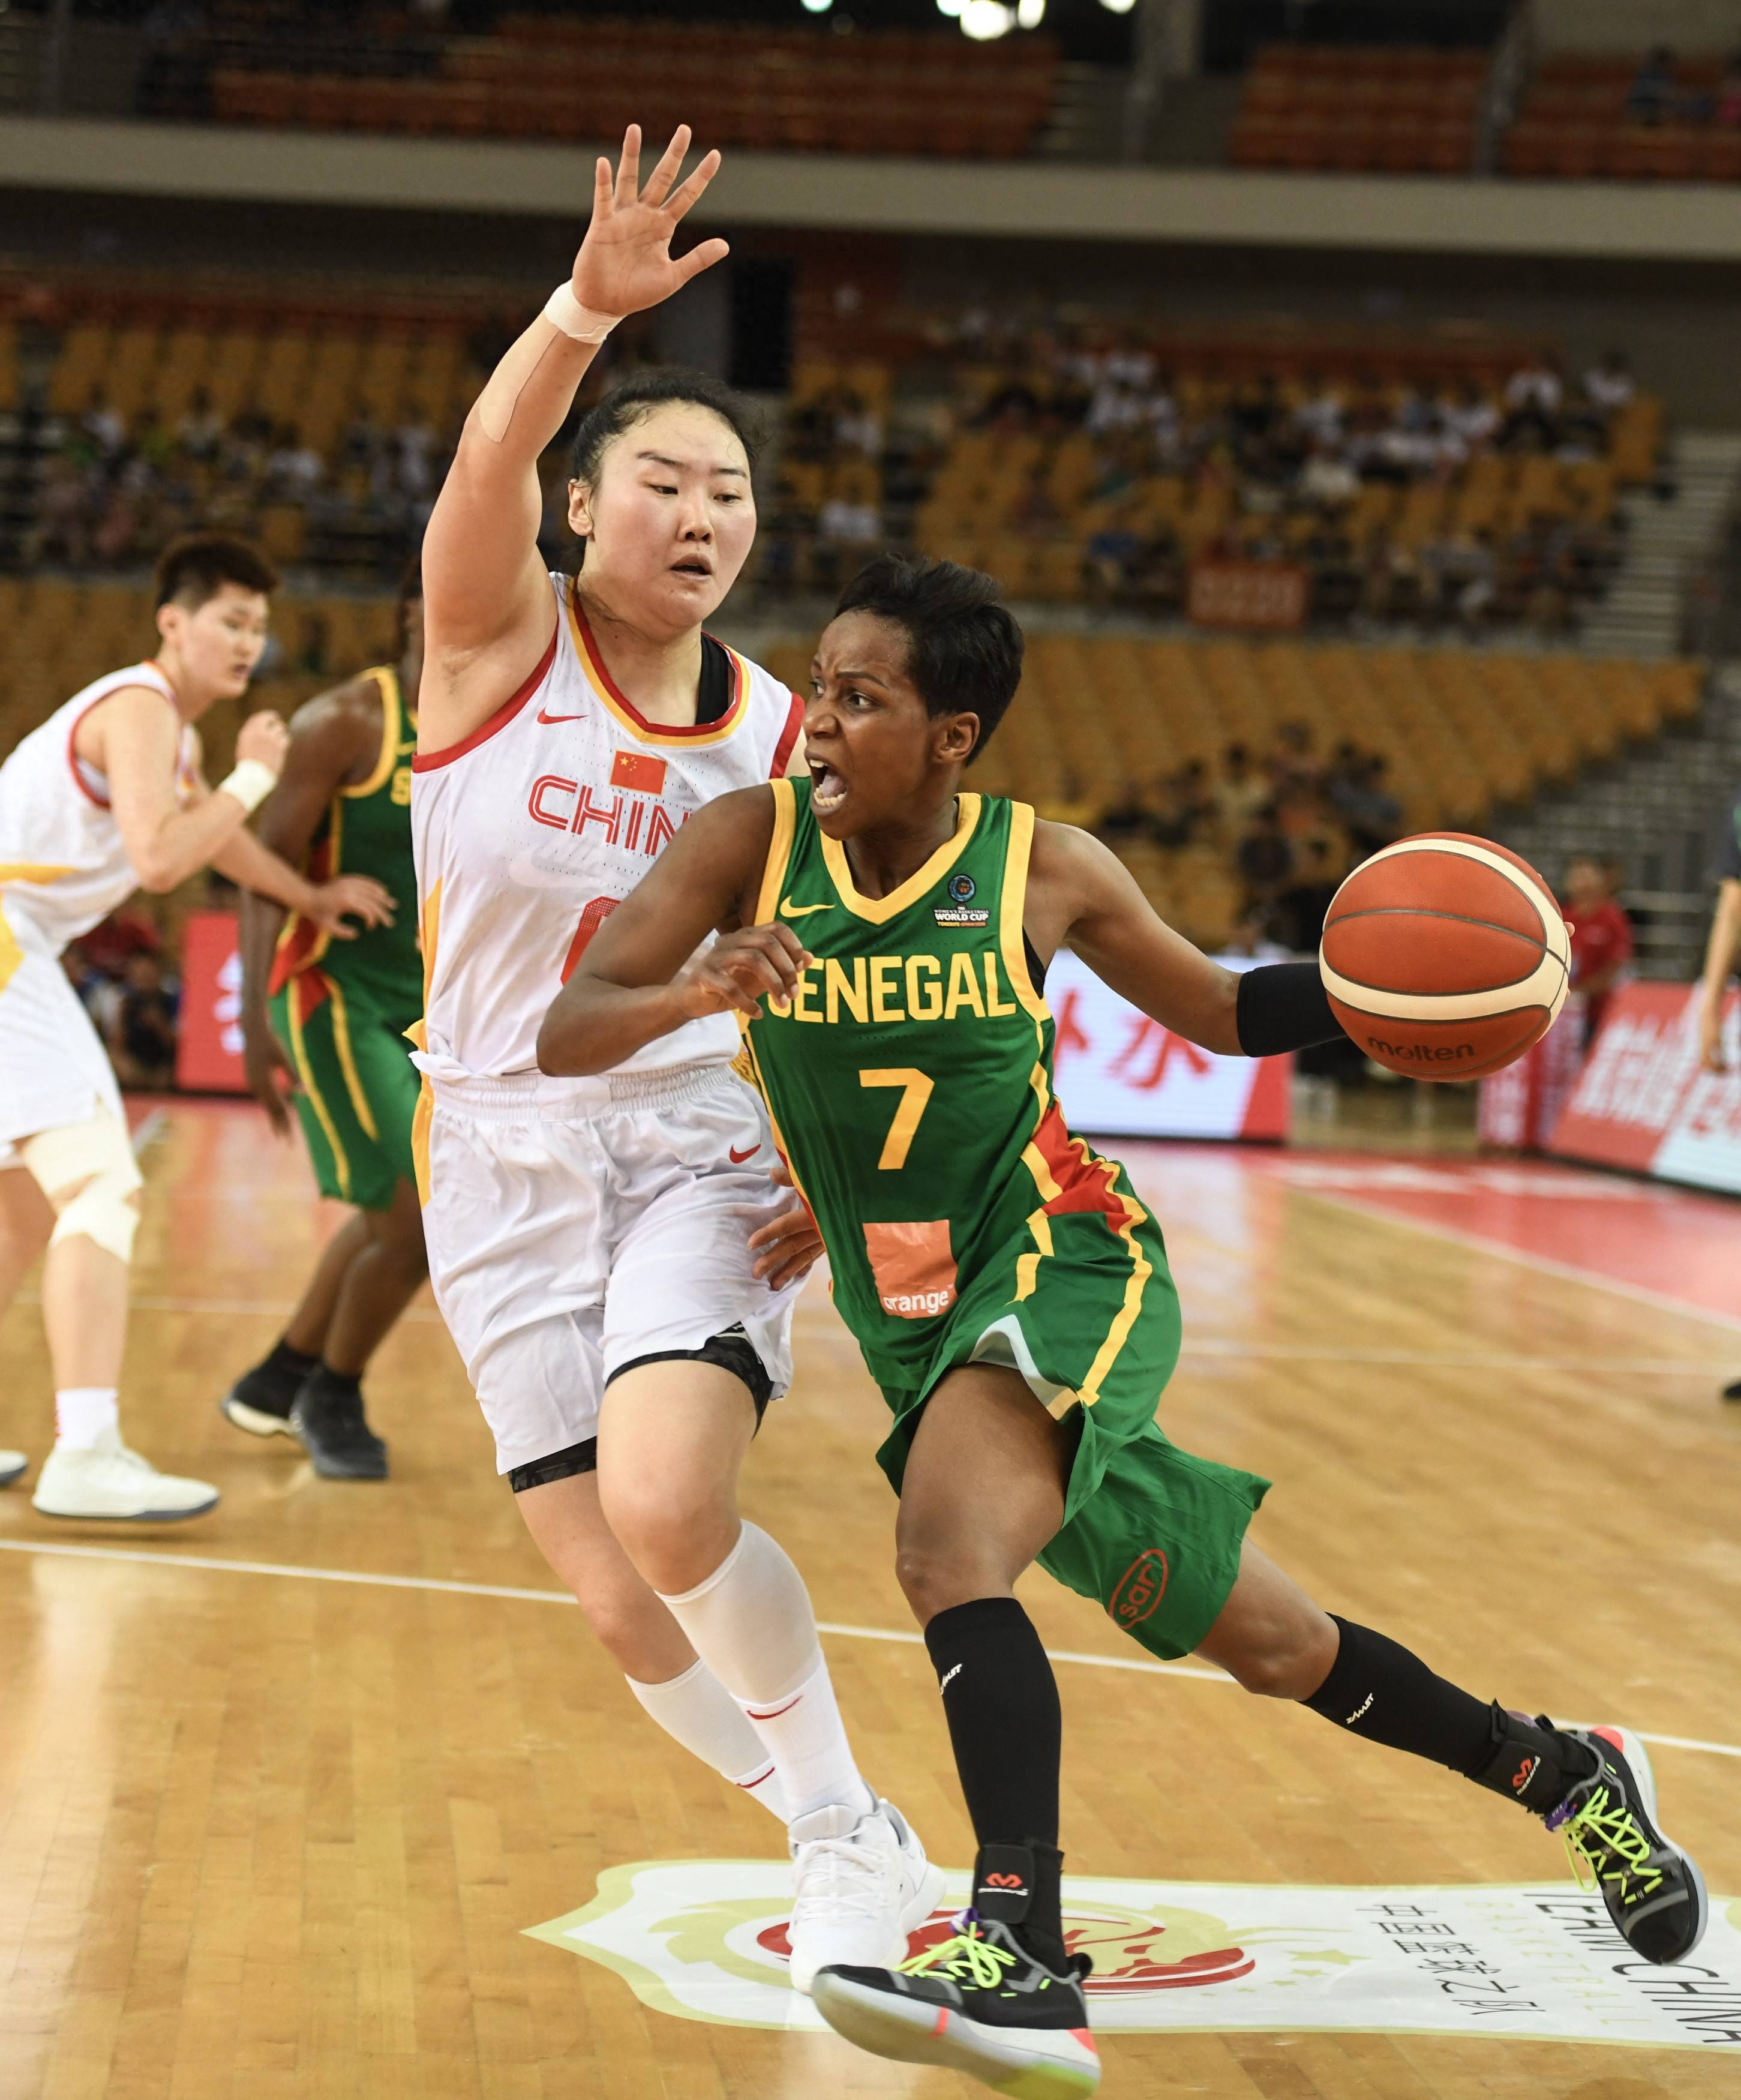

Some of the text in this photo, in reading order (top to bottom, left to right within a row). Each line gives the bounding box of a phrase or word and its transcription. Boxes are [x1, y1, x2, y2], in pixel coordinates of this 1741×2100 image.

[528, 775, 693, 856] CHIN
[1367, 1036, 1475, 1061] molten
[859, 1067, 935, 1171] 7
[883, 1290, 949, 1315] orange
[1119, 1562, 1155, 1618] sar
[1355, 1904, 1546, 2015] 中国篮球之队
